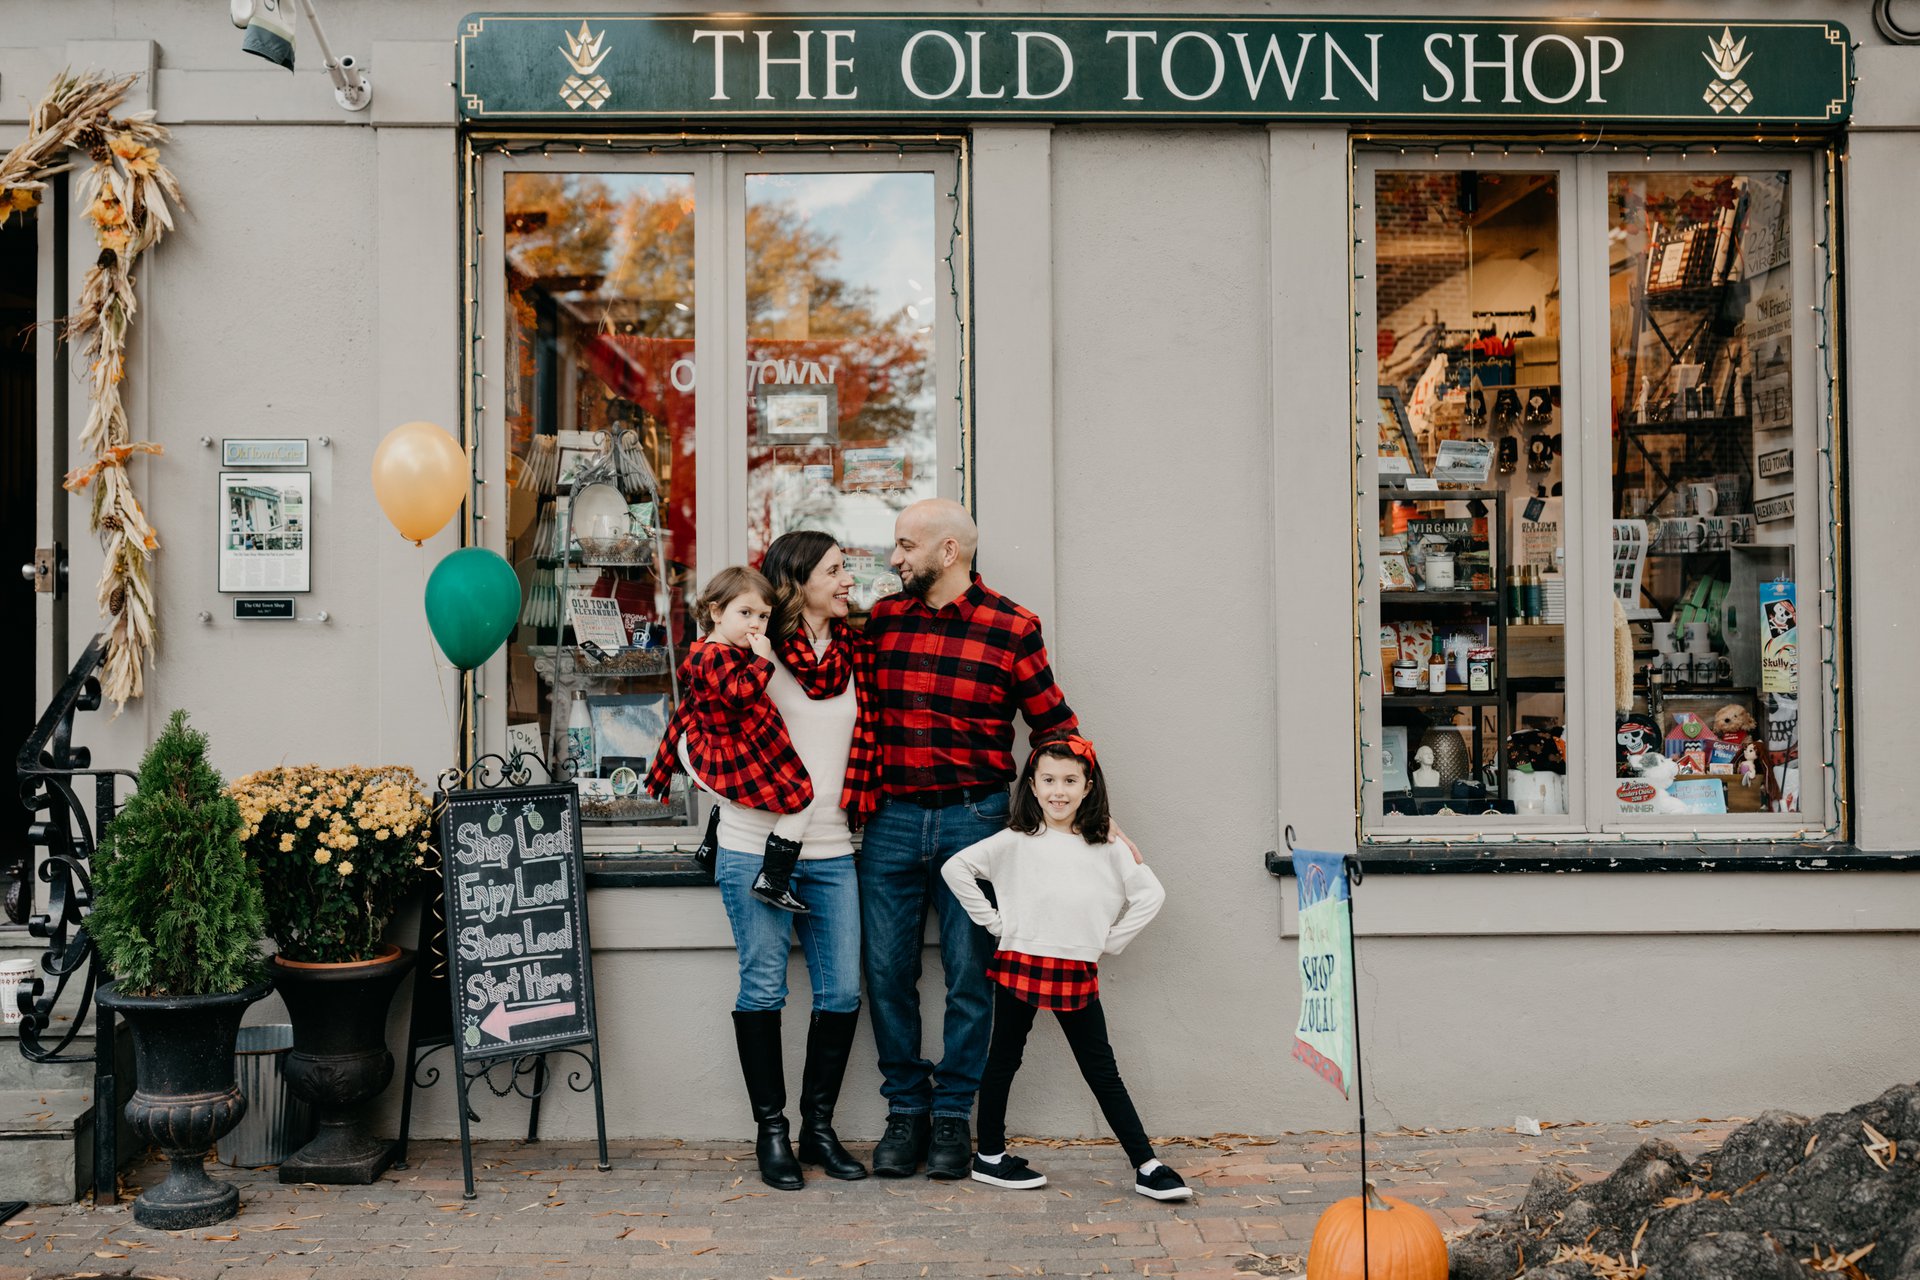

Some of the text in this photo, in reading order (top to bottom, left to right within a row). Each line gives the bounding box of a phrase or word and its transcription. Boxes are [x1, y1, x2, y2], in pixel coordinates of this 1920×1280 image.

[692, 29, 1625, 104] THE OLD TOWN SHOP
[1748, 246, 1791, 274] VIRGINI
[1761, 459, 1772, 473] OLD
[1413, 522, 1469, 533] VIRGINIA
[571, 598, 617, 610] OLD TOWN
[574, 608, 619, 617] ALEXANDRIA
[621, 612, 648, 621] VIRGINIA
[1763, 658, 1788, 670] Skully
[1713, 741, 1730, 751] Good
[1619, 804, 1654, 813] WINNER
[455, 810, 572, 869] Shop Local
[458, 861, 570, 923] Enjoy Local
[457, 911, 573, 961] Share Local
[1302, 953, 1335, 993] SHOP
[466, 962, 573, 1011] Start Here
[1299, 997, 1337, 1033] LOCAL
